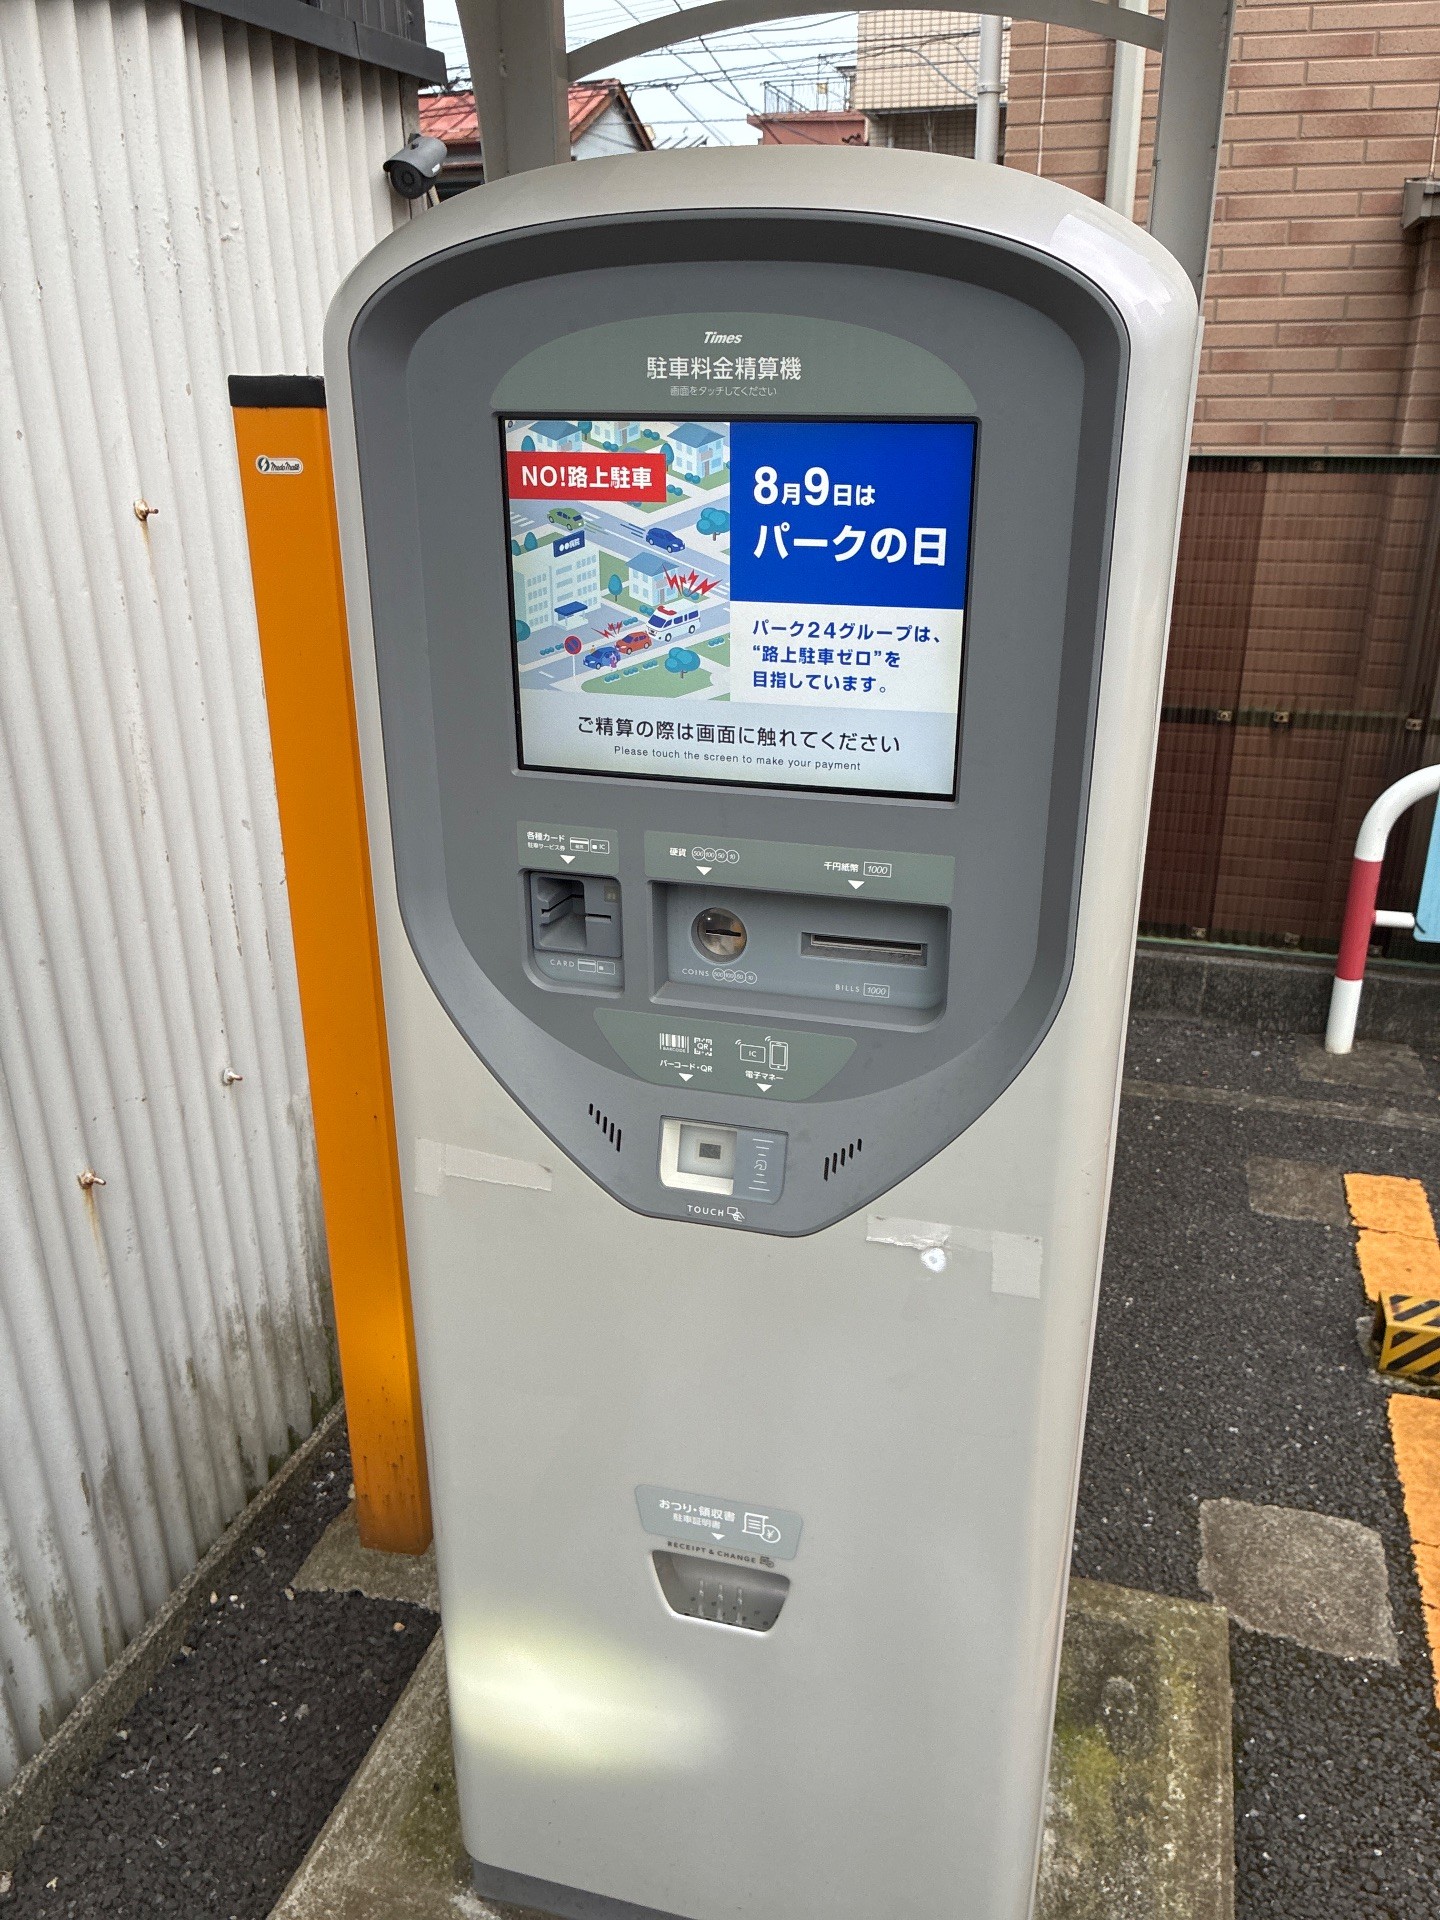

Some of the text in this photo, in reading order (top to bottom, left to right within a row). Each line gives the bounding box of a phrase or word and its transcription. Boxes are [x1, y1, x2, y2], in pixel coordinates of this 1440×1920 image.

[704, 331, 743, 344] Times
[646, 356, 802, 381] 駐車料金精算機
[670, 385, 777, 397] 画面をタッチしてください
[521, 465, 653, 489] NO!路上駐車
[753, 466, 876, 506] 8月9日は
[753, 521, 947, 566] パークの日
[752, 619, 940, 643] パーク24グループは、
[753, 670, 886, 693] 目指しています。
[578, 716, 900, 753] ご精算の際は画面に触れてください
[614, 745, 861, 771] Please touch the screen to make your payment
[526, 831, 566, 843] 各種カード
[823, 861, 888, 875] 千円紙幣 1000
[549, 958, 575, 968] CARD
[681, 968, 710, 977] COINS
[835, 983, 887, 996] BILLS 1000
[697, 1042, 709, 1050] QR
[748, 1050, 757, 1058] IC
[659, 1059, 713, 1073] バーコード・QR
[745, 1070, 784, 1081] 電子マネー
[686, 1204, 725, 1217] TOUCH
[658, 1499, 736, 1523] おつり・領収書
[667, 1540, 706, 1553] RECEIPT
[716, 1550, 757, 1564] CHANGE
